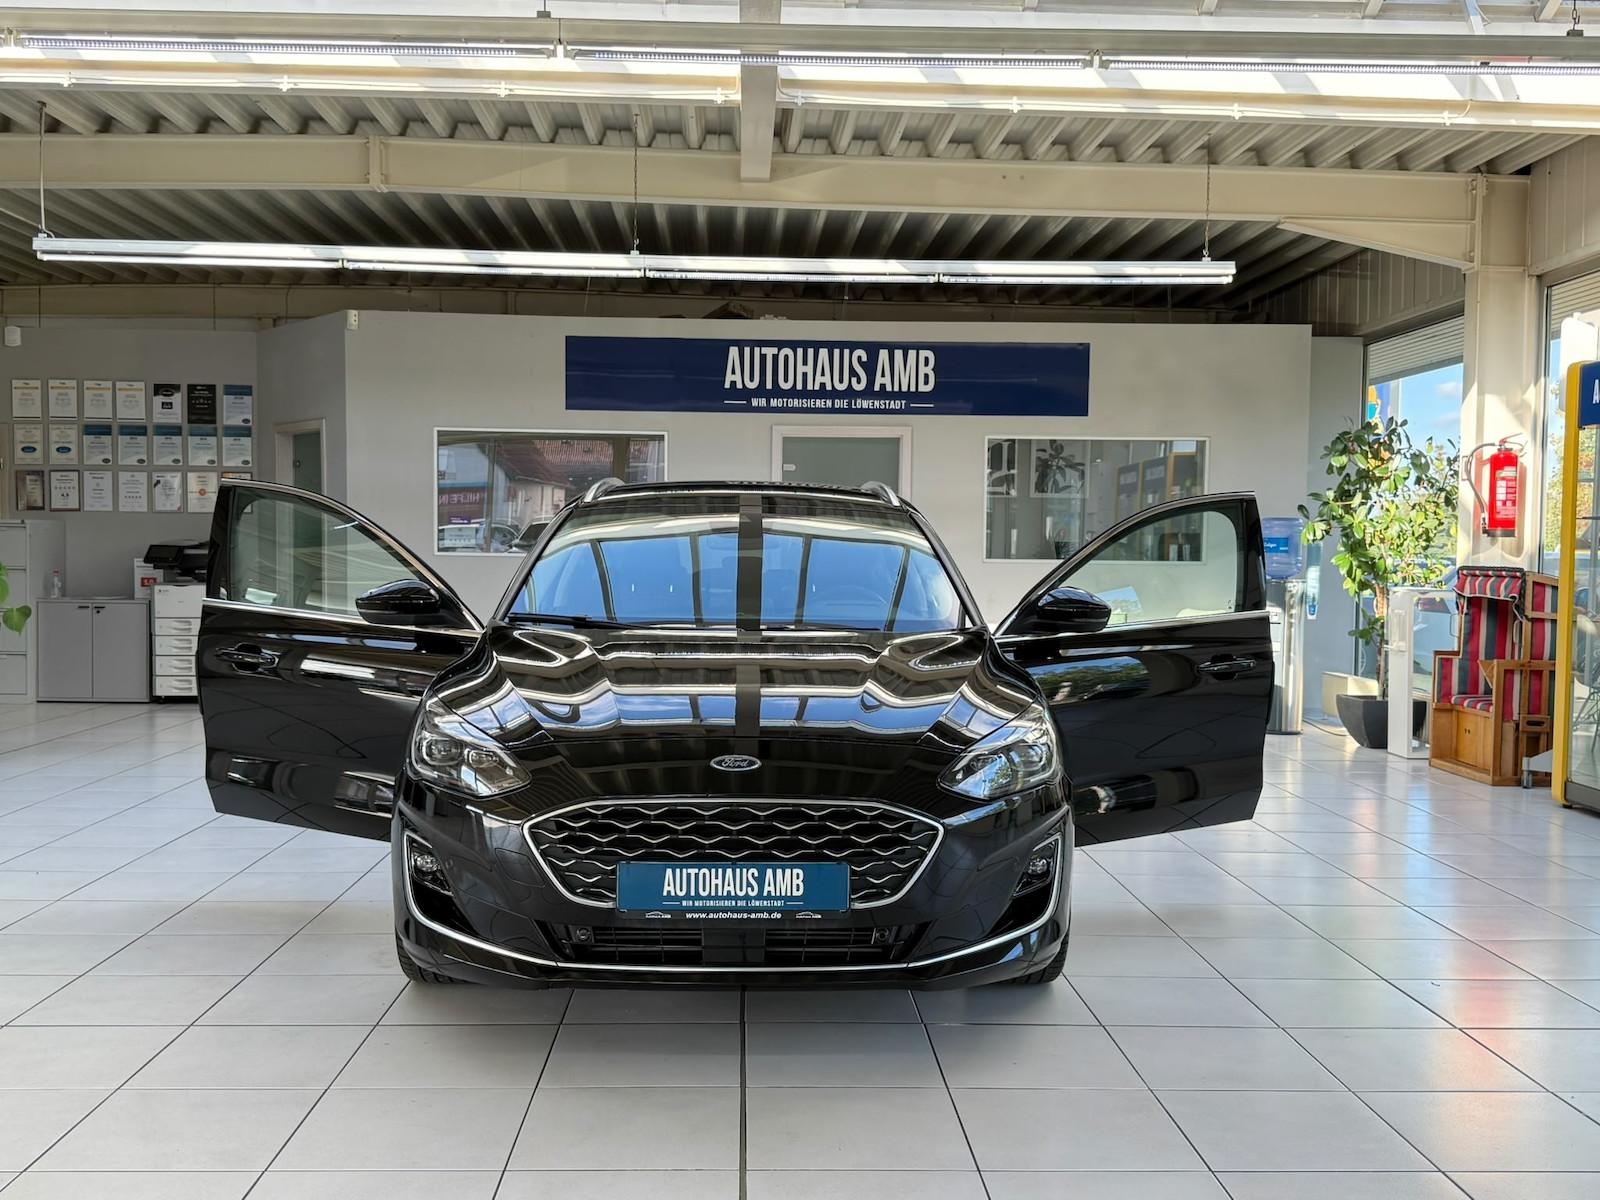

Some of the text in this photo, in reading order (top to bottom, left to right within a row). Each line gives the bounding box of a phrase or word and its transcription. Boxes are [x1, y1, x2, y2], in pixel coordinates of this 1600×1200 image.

[724, 346, 936, 392] AUTOHAUS AMB
[751, 398, 906, 409] WIR MOTORISIEREN DIE LÖWENSTADT
[721, 758, 750, 767] Ford
[663, 868, 804, 897] AUTOHAUS AMB
[686, 911, 782, 919] www.autohaus-amb.de
